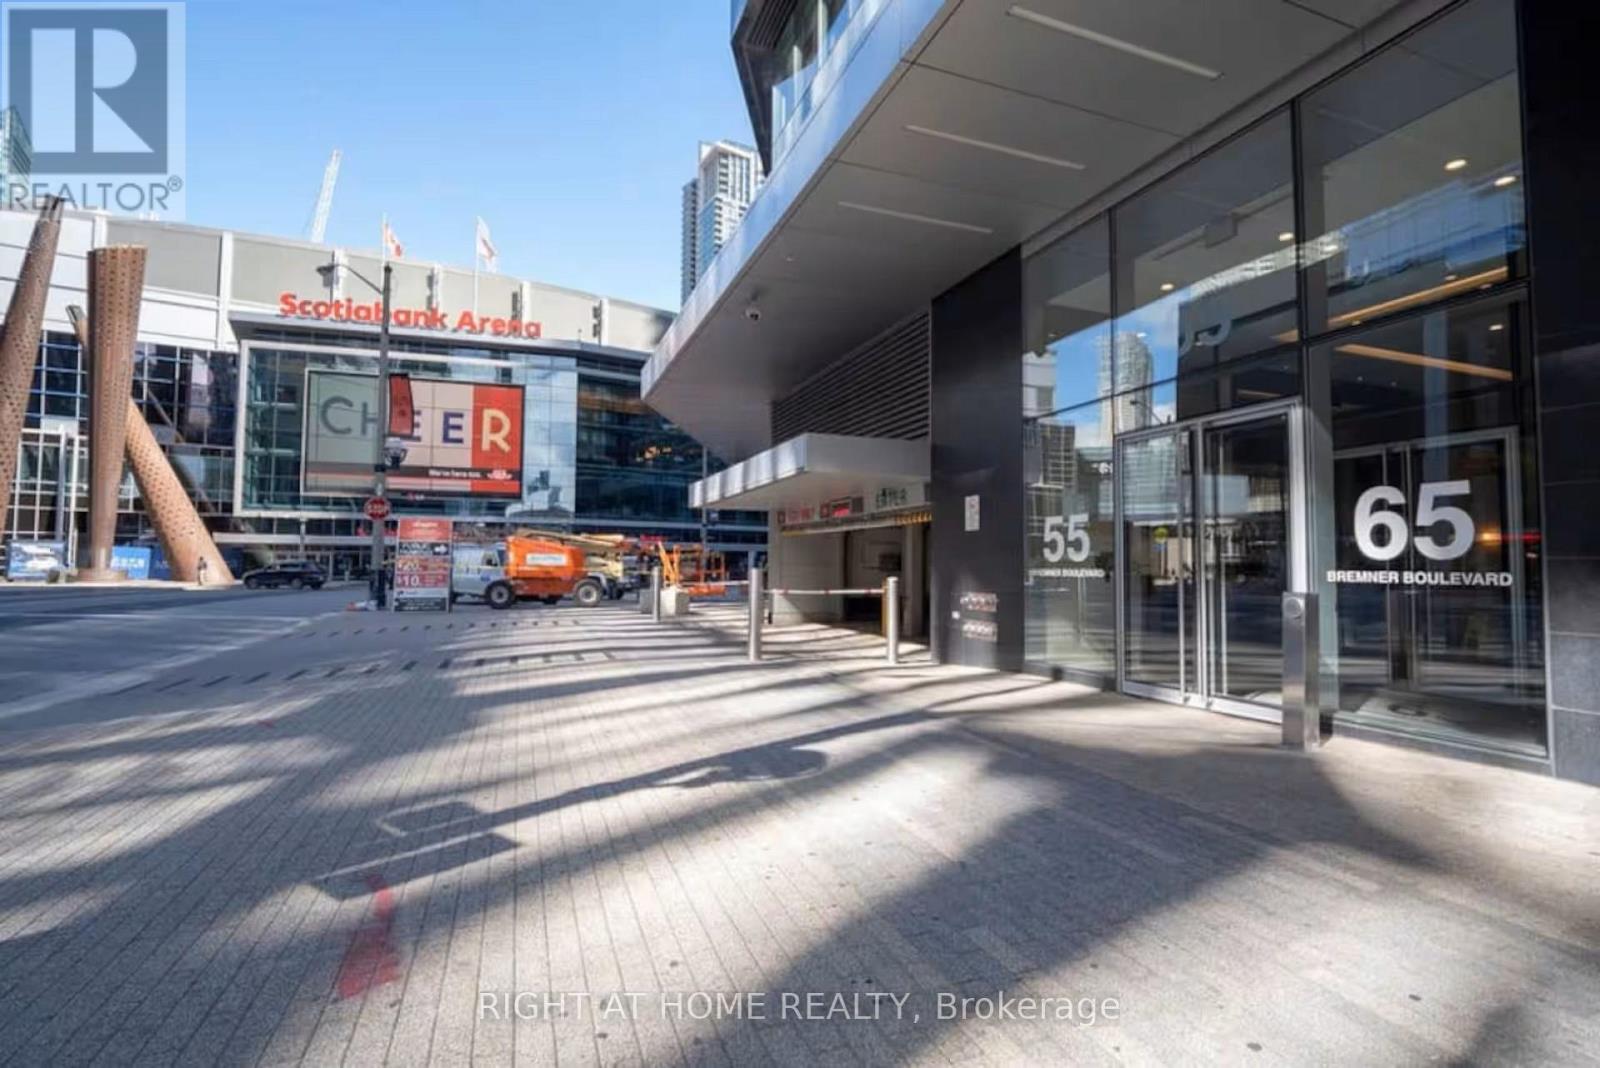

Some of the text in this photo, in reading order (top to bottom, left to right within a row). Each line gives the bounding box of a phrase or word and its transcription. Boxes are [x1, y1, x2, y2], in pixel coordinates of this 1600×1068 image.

[279, 291, 542, 339] Scotiabank Arena
[321, 396, 511, 452] CHER
[1043, 513, 1090, 562] 55
[1354, 480, 1475, 561] 65
[1326, 570, 1513, 587] BREMNER BOULEVARD
